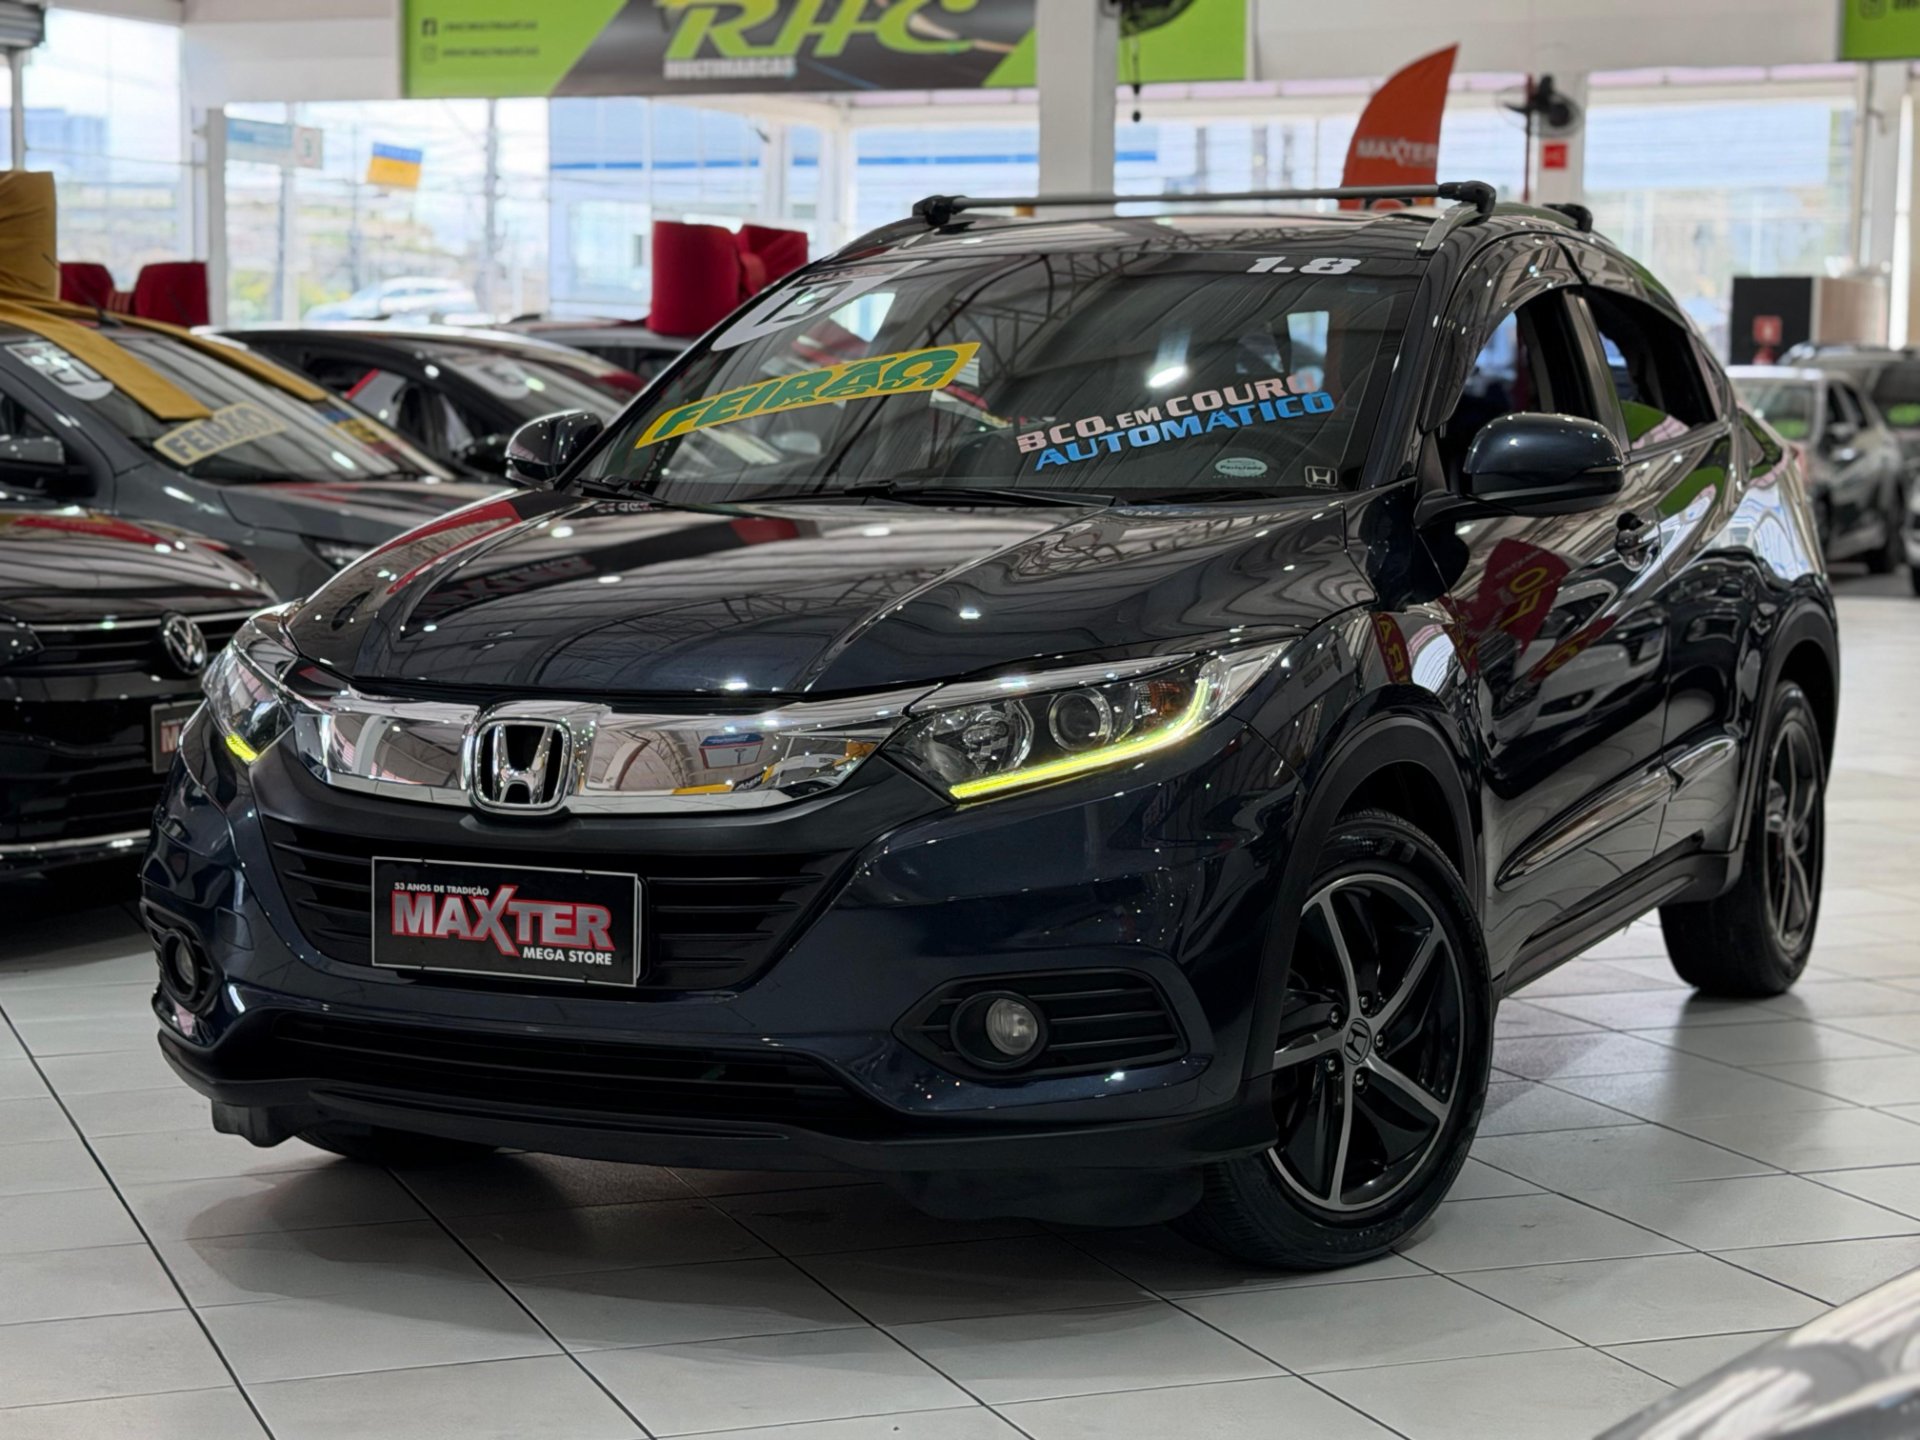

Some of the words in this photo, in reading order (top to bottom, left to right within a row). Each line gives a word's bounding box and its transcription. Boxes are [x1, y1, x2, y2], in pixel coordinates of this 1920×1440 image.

[1246, 256, 1362, 275] 1.8
[652, 349, 960, 440] FEIRÃO
[1116, 406, 1162, 429] EM
[1165, 371, 1323, 417] COURO
[1034, 391, 1335, 472] AUTOMÁTICO
[394, 882, 405, 891] 53
[406, 883, 432, 892] ANOS
[433, 885, 445, 893] DE
[446, 885, 490, 897] TRADIÇÃO
[392, 885, 616, 957] MAXTER
[523, 946, 565, 961] MEGA
[568, 950, 613, 966] STORE
